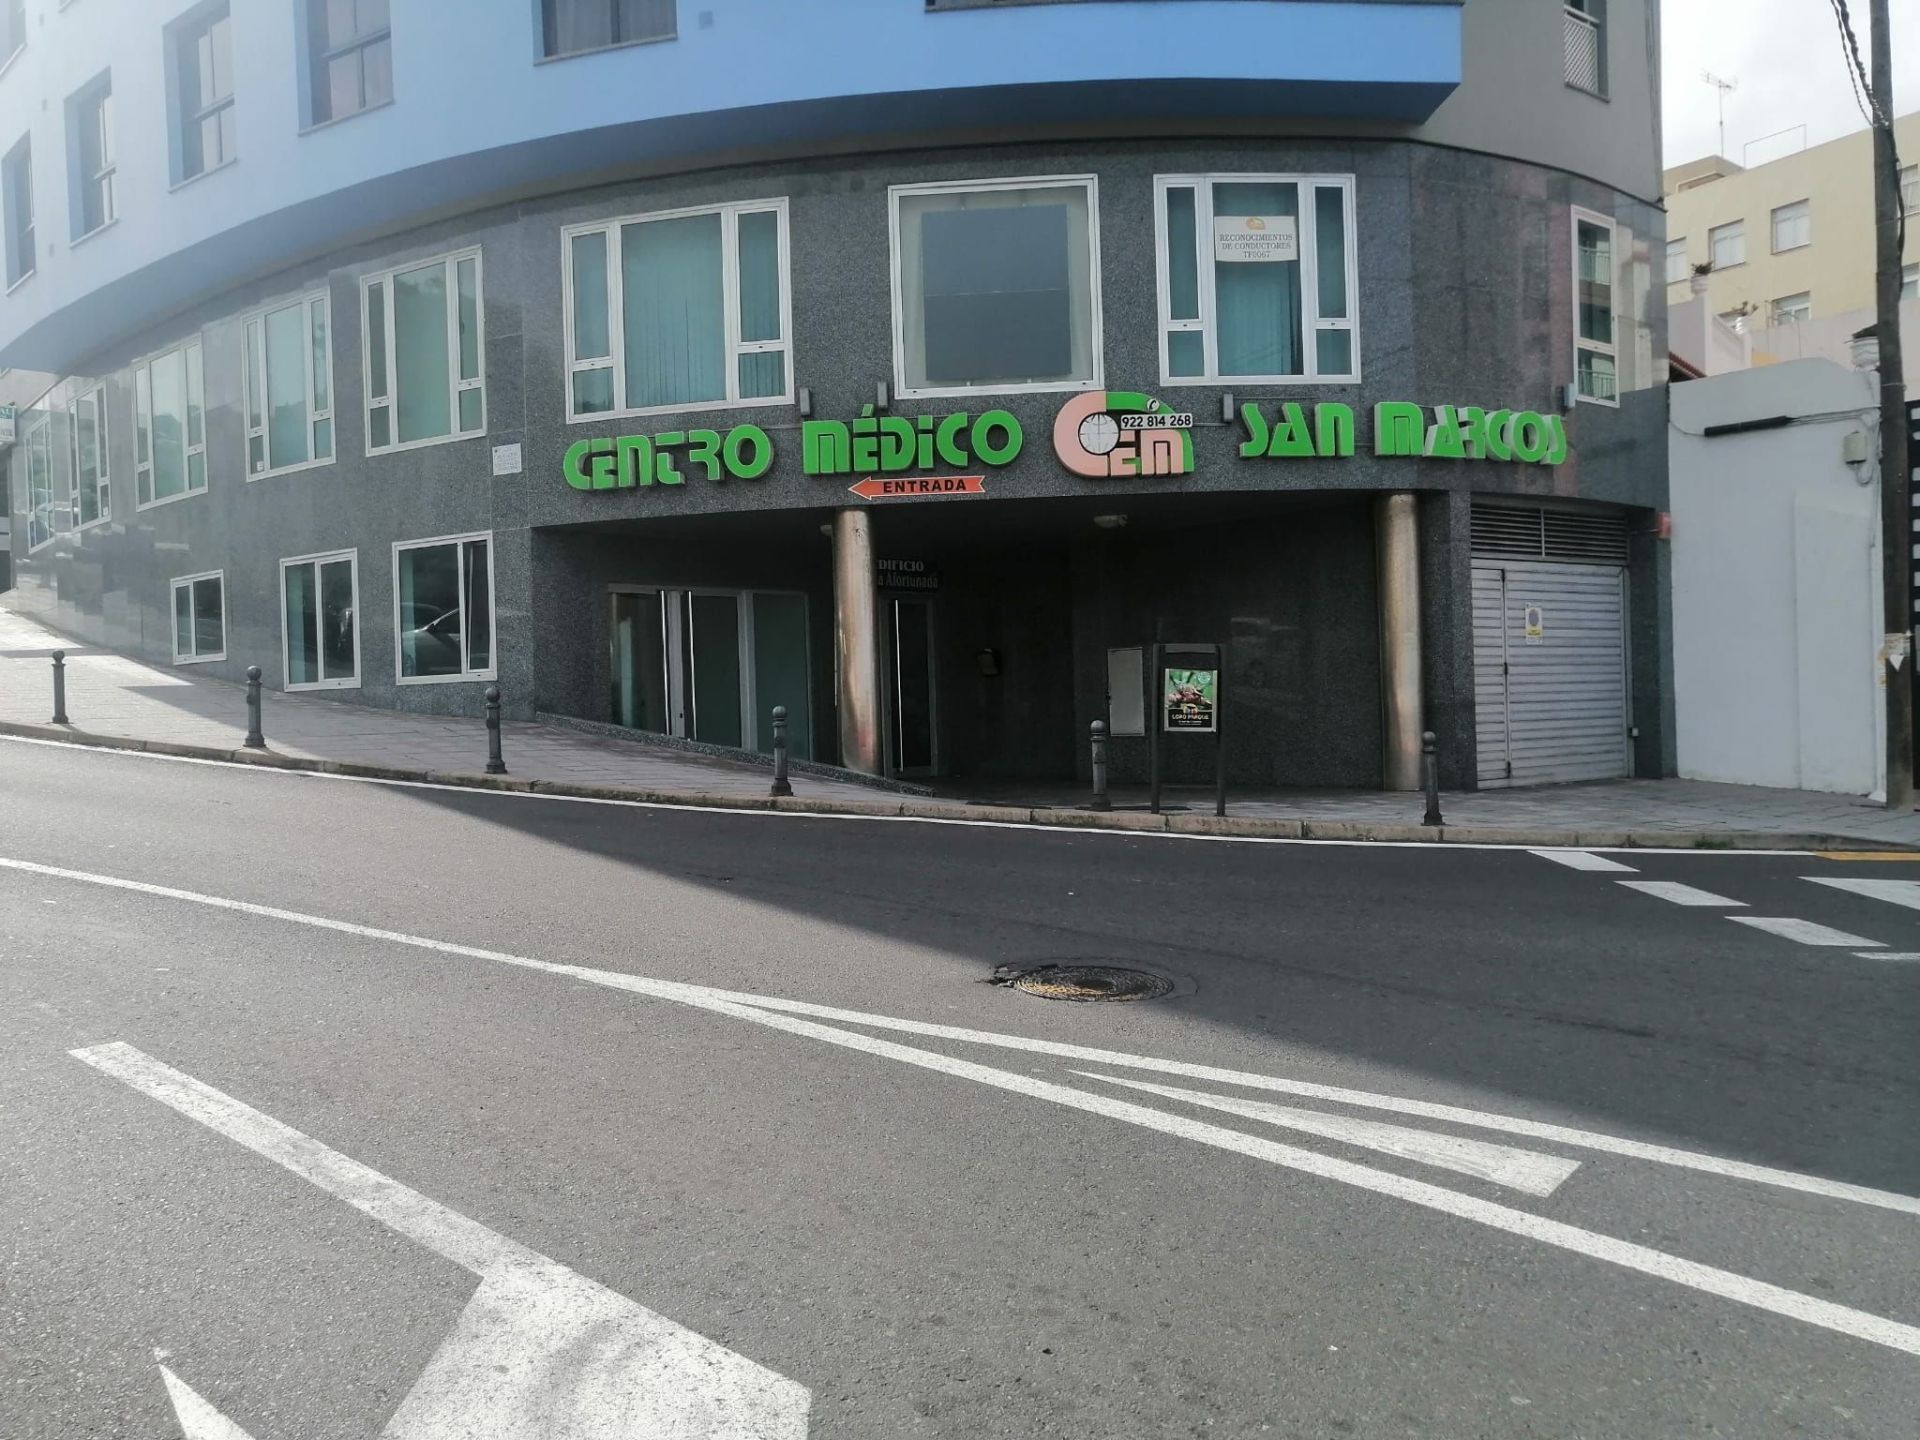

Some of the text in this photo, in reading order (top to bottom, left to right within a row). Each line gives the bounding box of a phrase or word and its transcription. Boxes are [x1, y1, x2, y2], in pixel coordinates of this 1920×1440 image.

[1219, 233, 1293, 242] RECONOCIMIENTOS
[1222, 242, 1292, 250] DE CONDUCTORES
[1121, 414, 1192, 428] 922 814 268
[1239, 401, 1568, 466] SAN MARCOS
[882, 479, 967, 494] ENTRADA
[878, 559, 925, 572] DIFICIO
